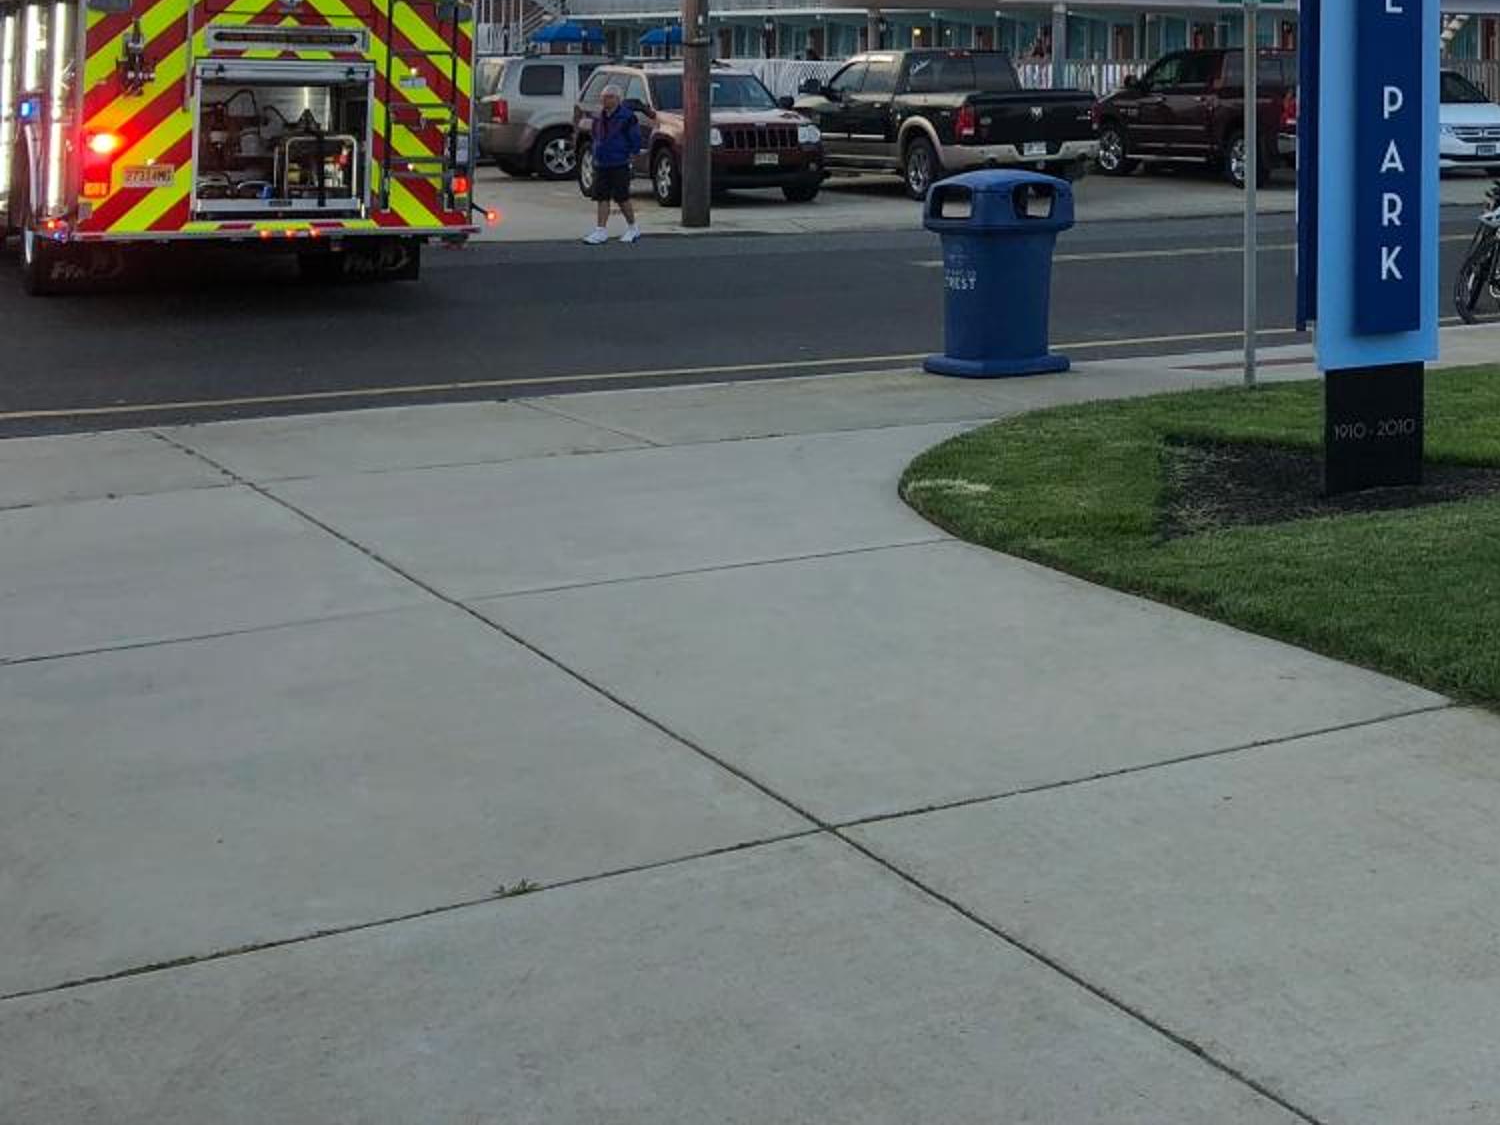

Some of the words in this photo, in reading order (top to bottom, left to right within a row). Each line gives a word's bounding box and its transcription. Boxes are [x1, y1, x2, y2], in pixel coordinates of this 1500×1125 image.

[1381, 85, 1405, 281] PARK
[1333, 421, 1367, 441] 1910
[1375, 418, 1416, 436] 2010
